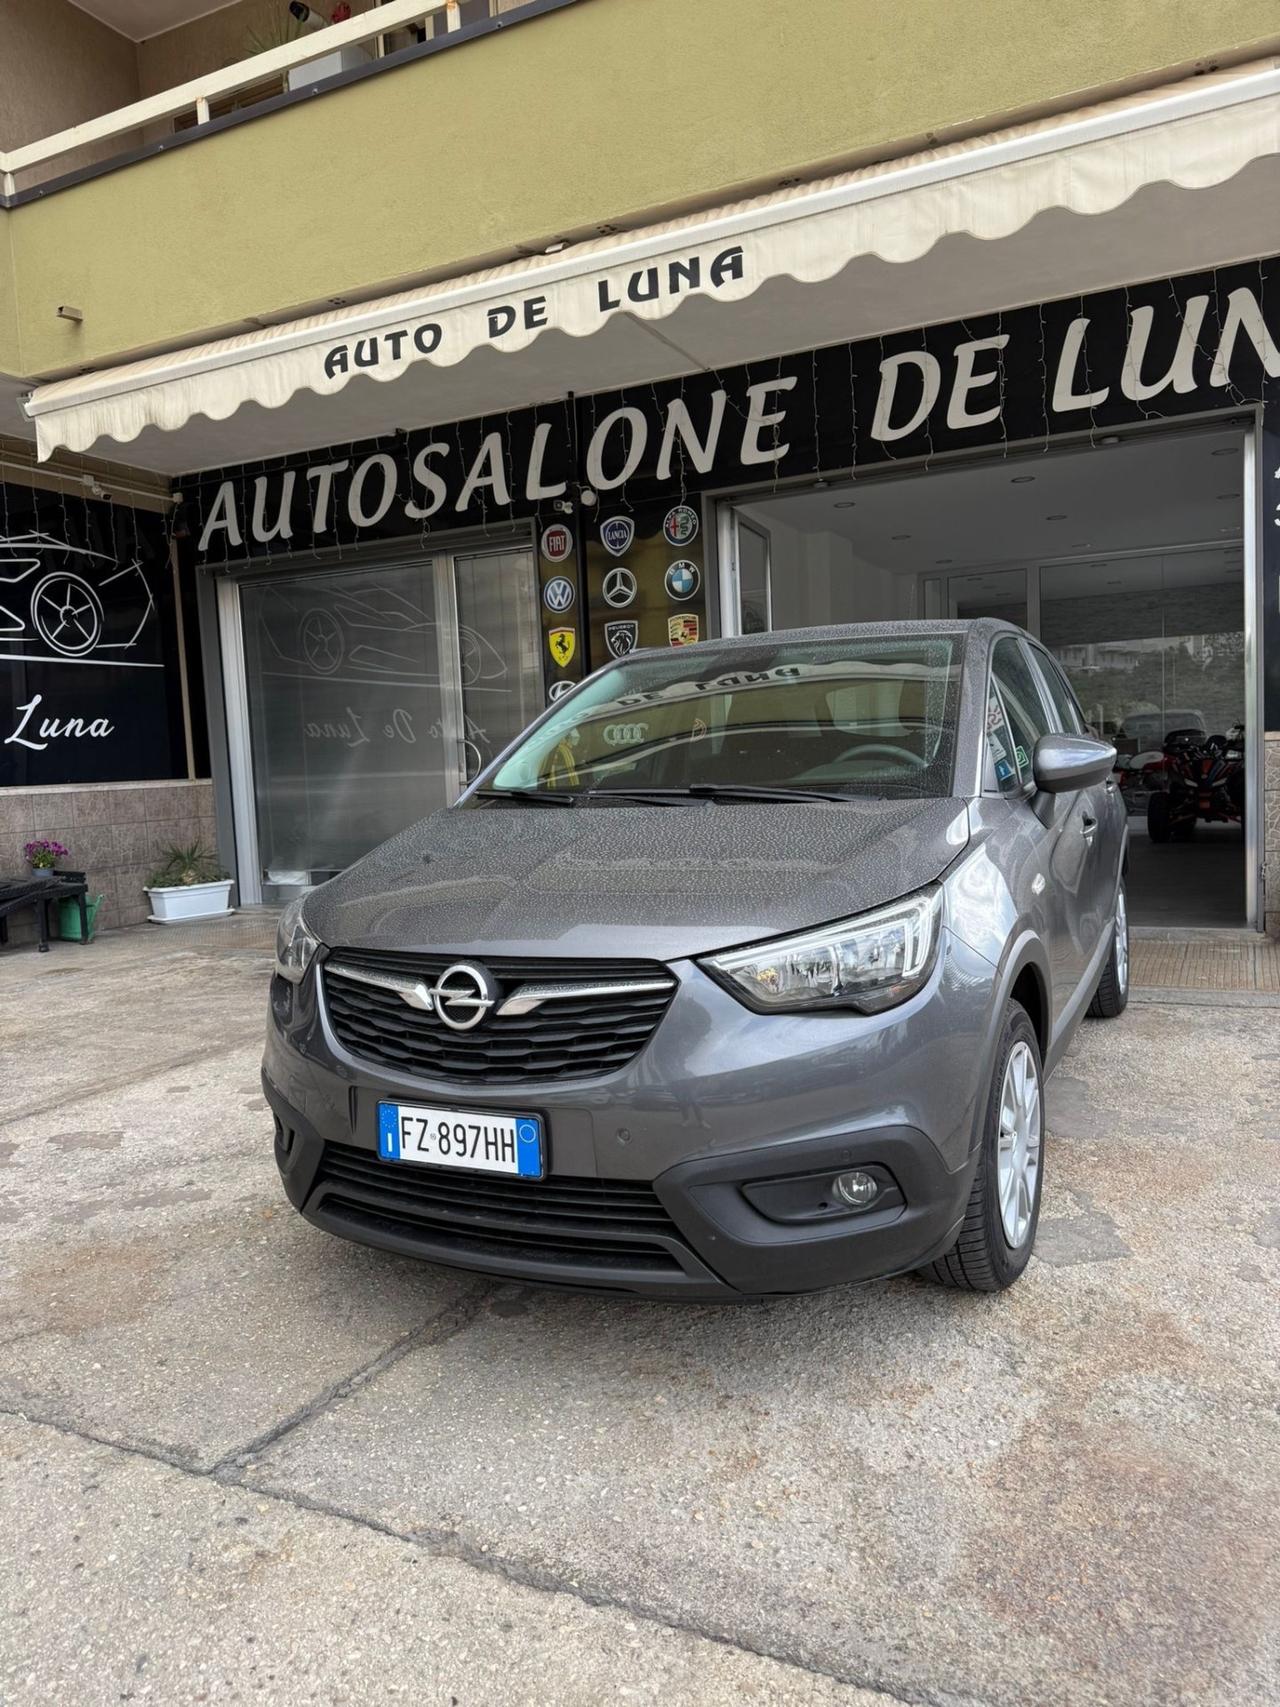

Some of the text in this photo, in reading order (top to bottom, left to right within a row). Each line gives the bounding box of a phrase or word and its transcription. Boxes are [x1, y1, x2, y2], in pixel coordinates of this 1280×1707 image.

[324, 246, 743, 379] AUTO DE LUNA
[198, 376, 798, 551] AUTOSALONE
[870, 334, 1010, 442] DE
[549, 535, 566, 553] FIAT
[4, 694, 115, 750] Luna
